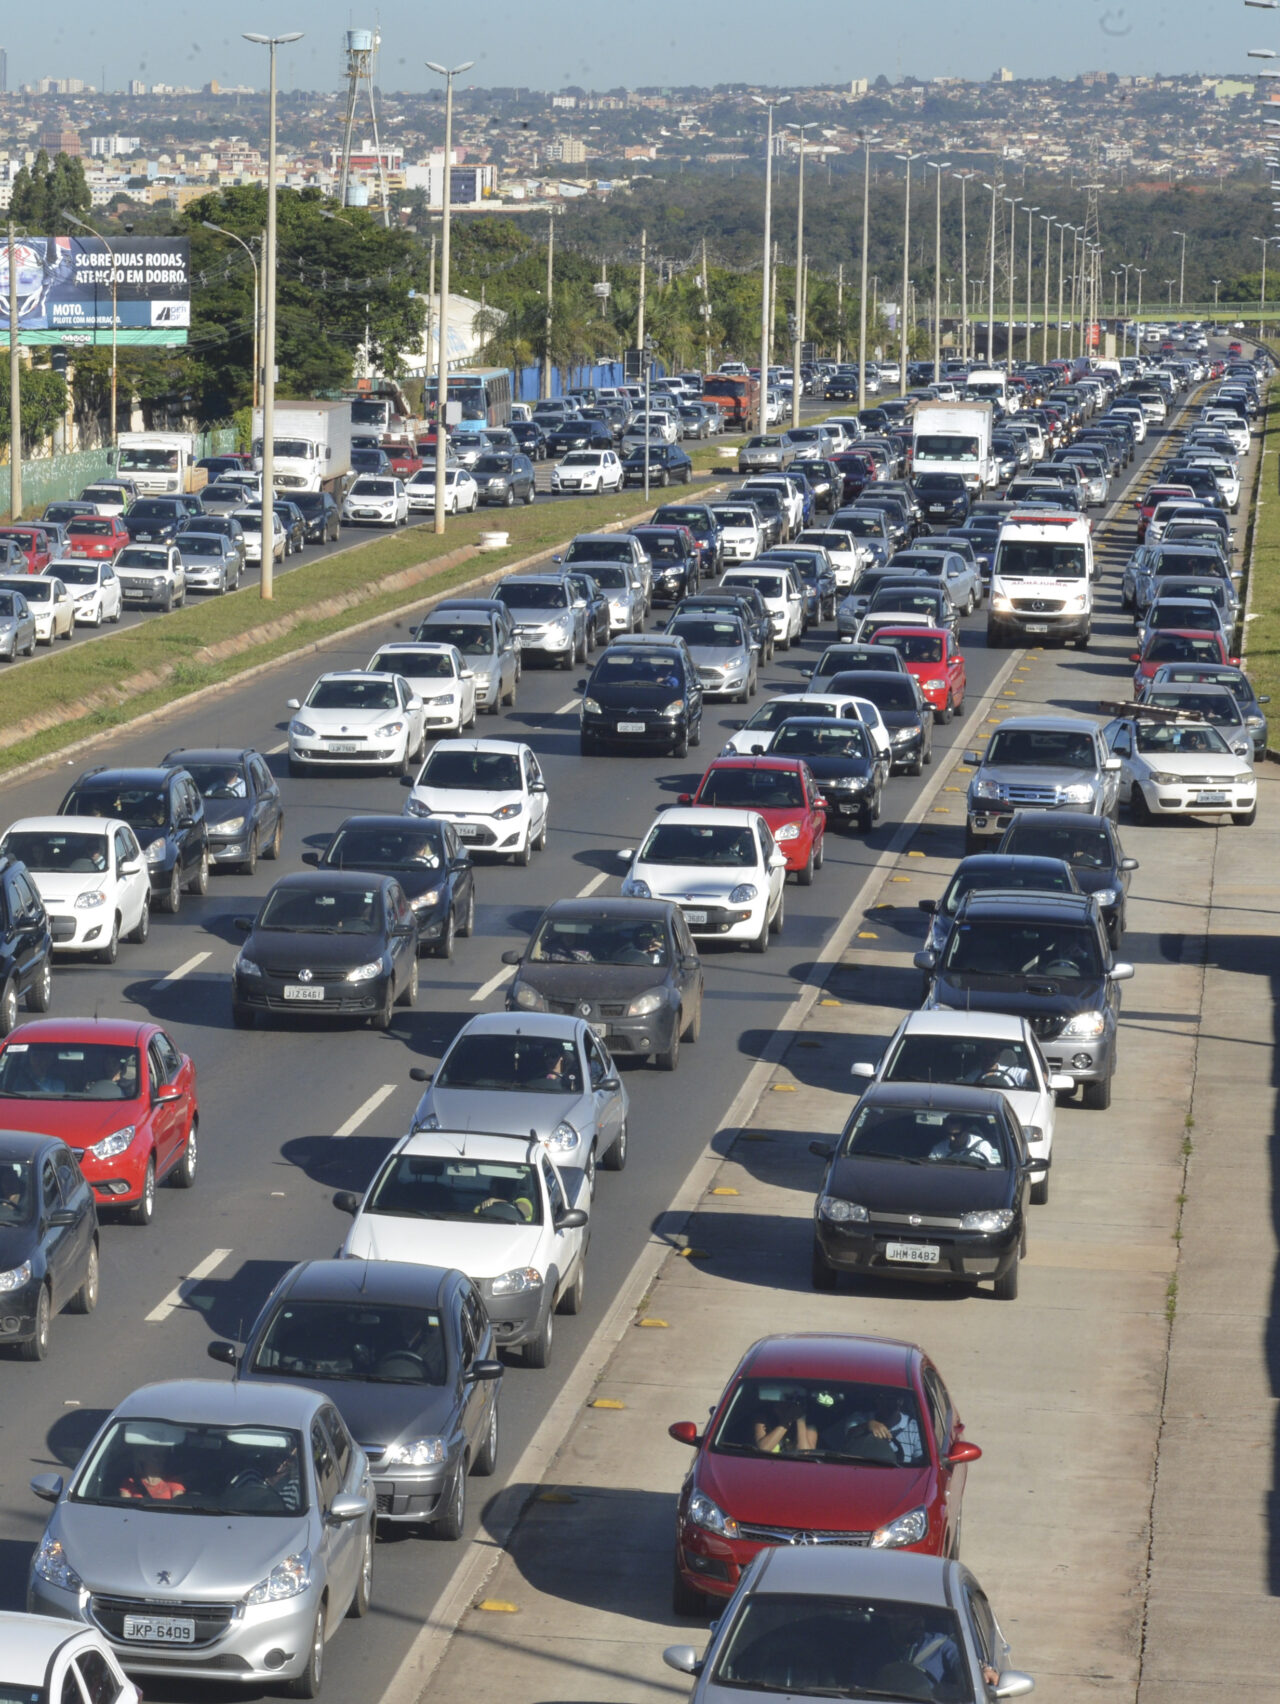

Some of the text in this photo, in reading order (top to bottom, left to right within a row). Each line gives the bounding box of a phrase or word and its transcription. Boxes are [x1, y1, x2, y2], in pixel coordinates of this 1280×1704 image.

[75, 253, 186, 268] SOBRE DUAS RODAS,
[76, 268, 187, 286] ATENÇÃO EM DOBRO.
[53, 304, 84, 316] MOTO.
[73, 316, 85, 324] COM
[86, 316, 122, 325] MOERAÇO.
